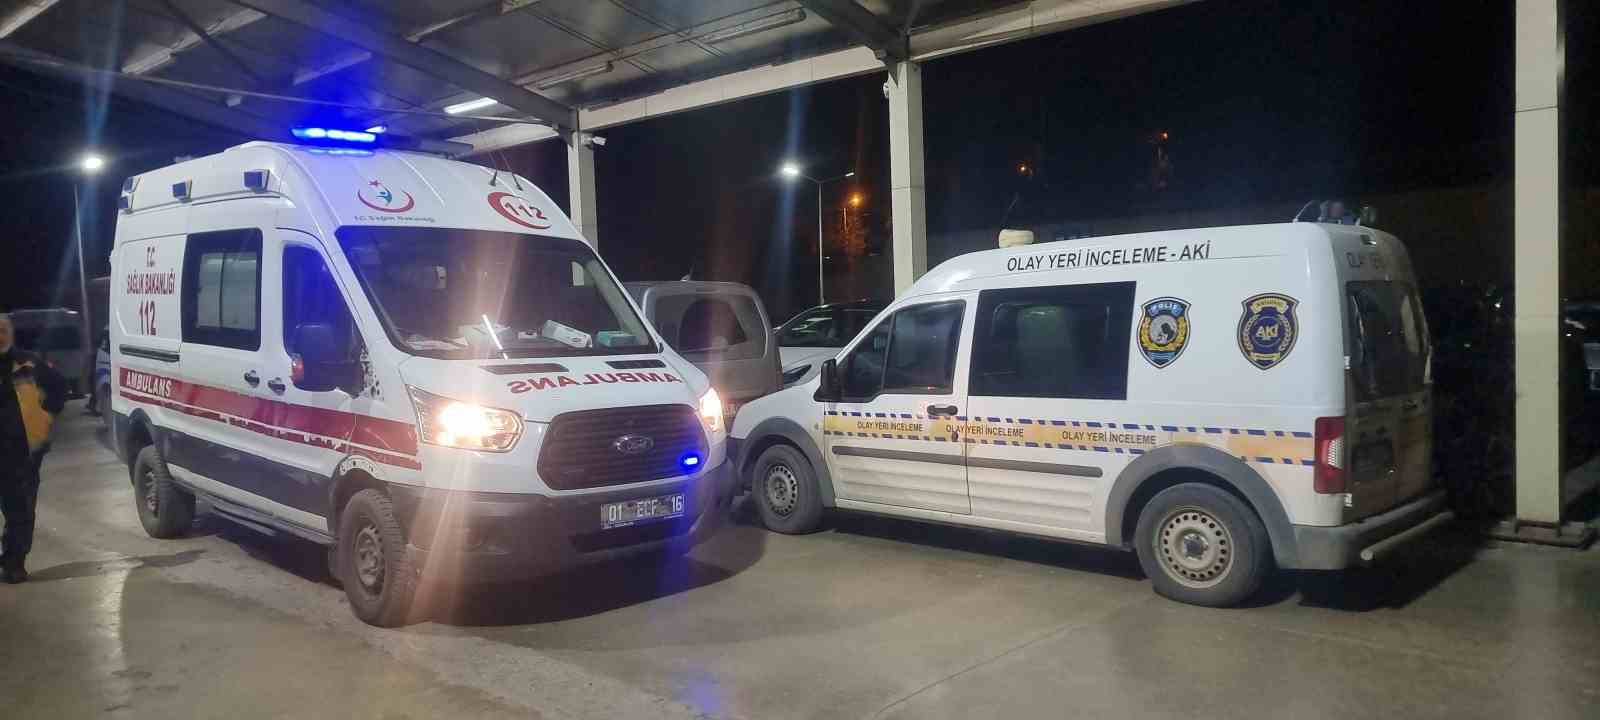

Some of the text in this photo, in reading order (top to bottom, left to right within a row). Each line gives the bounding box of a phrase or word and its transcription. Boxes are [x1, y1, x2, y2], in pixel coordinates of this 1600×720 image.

[504, 202, 548, 220] 112
[1007, 255, 1044, 272] OLAY
[1048, 251, 1081, 269] YERİ
[1085, 245, 1168, 267] İNCELEME
[1179, 240, 1212, 262] AKİ
[138, 300, 157, 336] 112
[126, 370, 172, 398] AMBULANS
[857, 421, 874, 430] OLAY
[945, 424, 965, 433] OLAY
[1062, 430, 1157, 445] OLAY YERİ İNCELEME
[608, 503, 622, 521] 01
[671, 495, 682, 513] 16
